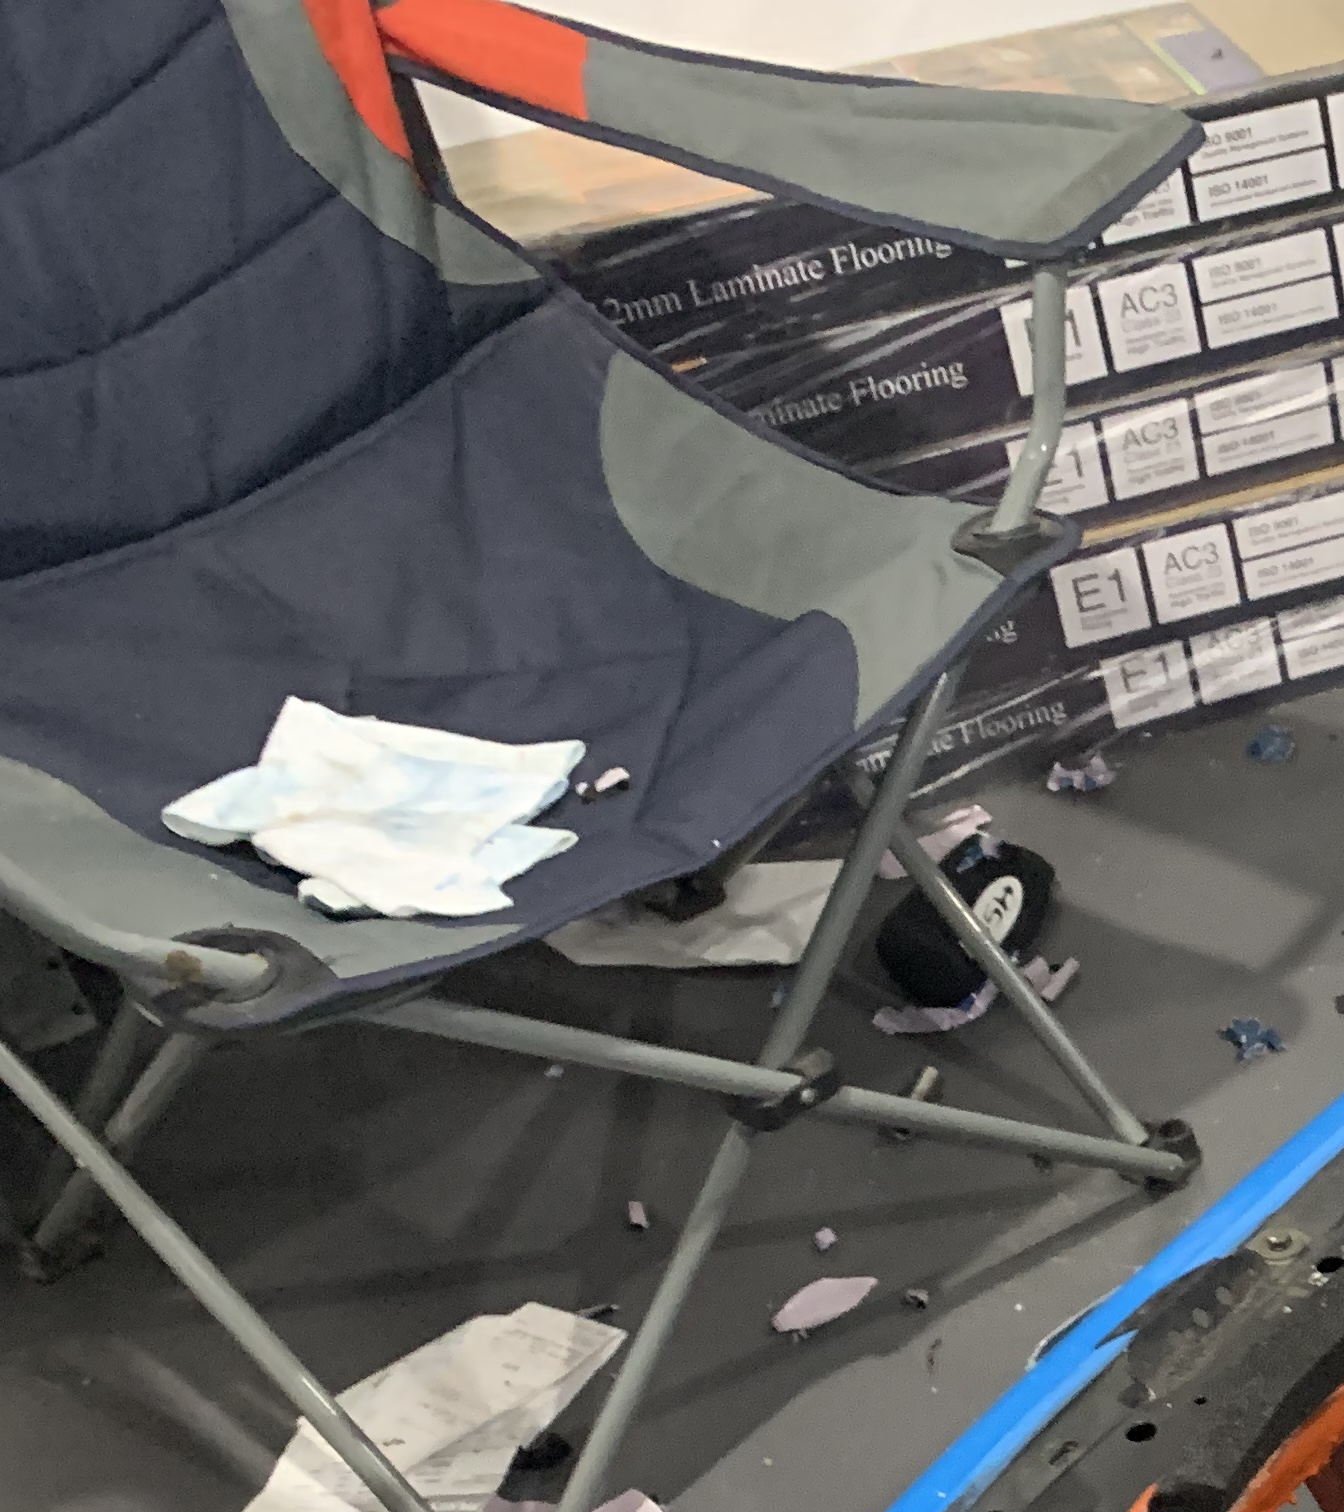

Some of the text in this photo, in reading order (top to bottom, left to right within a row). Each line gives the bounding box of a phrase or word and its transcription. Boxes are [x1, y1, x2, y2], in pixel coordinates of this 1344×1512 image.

[1208, 182, 1232, 198] ISO
[687, 256, 825, 307] Laminate
[1120, 283, 1178, 319] AC3
[848, 361, 969, 406] Flooring
[1122, 417, 1179, 451] AC3
[1163, 541, 1219, 576] AC3
[1071, 568, 1129, 613] E1
[956, 699, 1067, 748] Flooring
